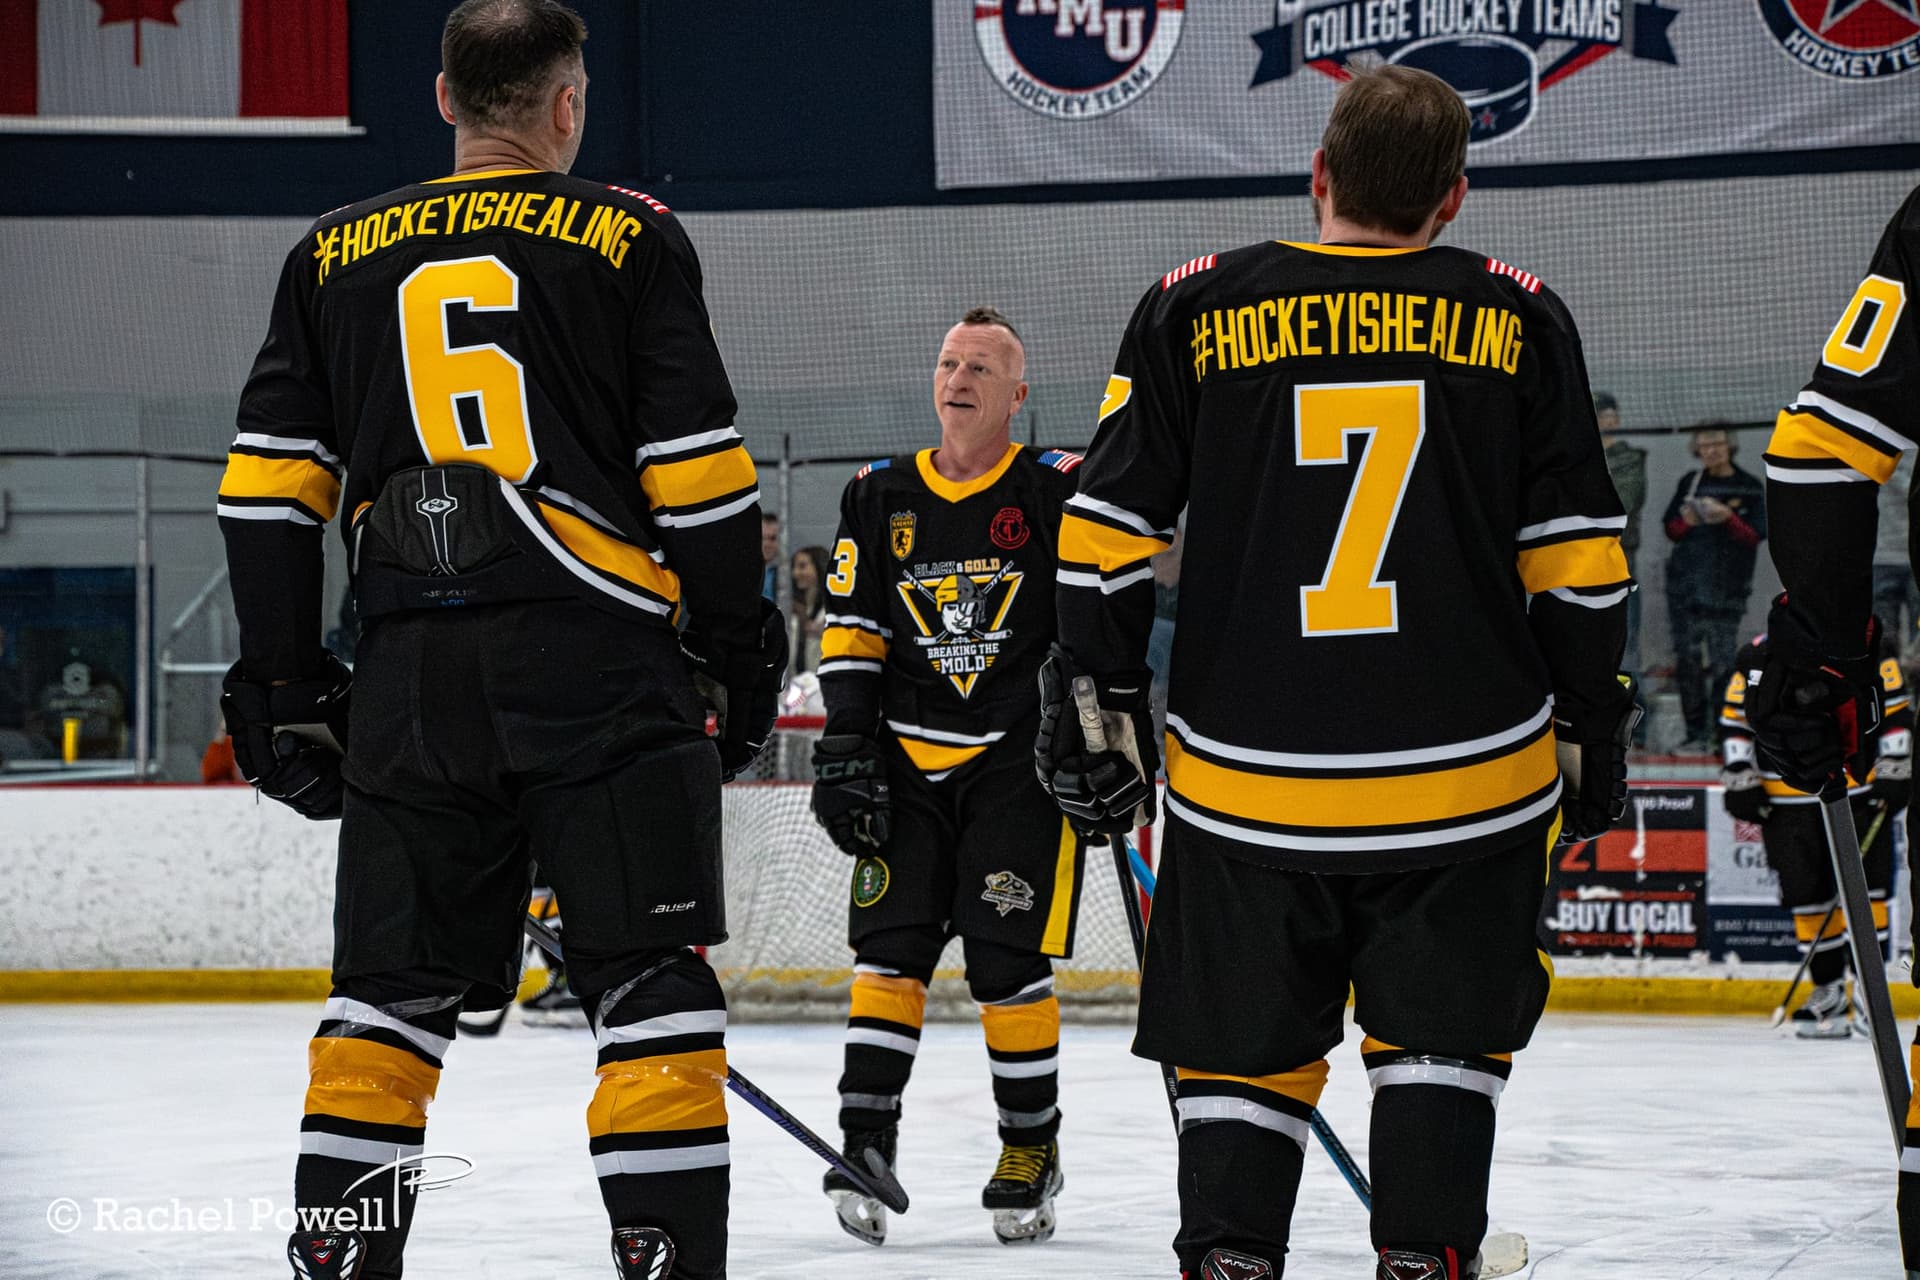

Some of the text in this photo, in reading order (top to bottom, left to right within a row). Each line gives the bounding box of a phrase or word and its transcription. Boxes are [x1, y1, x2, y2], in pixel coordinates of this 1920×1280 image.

[1016, 0, 1146, 62] MU
[1304, 0, 1412, 59] COLLEGE
[1419, 0, 1521, 37] HOCKEY
[1532, 0, 1623, 42] TEAMS
[1784, 28, 1920, 77] HOCKEY TE
[1006, 65, 1151, 113] HOCKEY TEAM
[313, 191, 642, 286] #HOCKEYISHEALING
[1190, 291, 1523, 383] #HOCKEYISHEALING
[1822, 273, 1907, 378] 0
[398, 254, 539, 485] 6
[1294, 379, 1426, 637] 7
[826, 538, 858, 597] 3
[914, 560, 956, 578] BLACK
[964, 557, 1001, 573] GOLD
[926, 642, 1001, 660] BREAKING THE
[941, 655, 986, 675] MOLD
[815, 759, 875, 781] CM
[1557, 900, 1697, 933] BUY LOCAL
[1389, 1259, 1429, 1271] VAPOR
